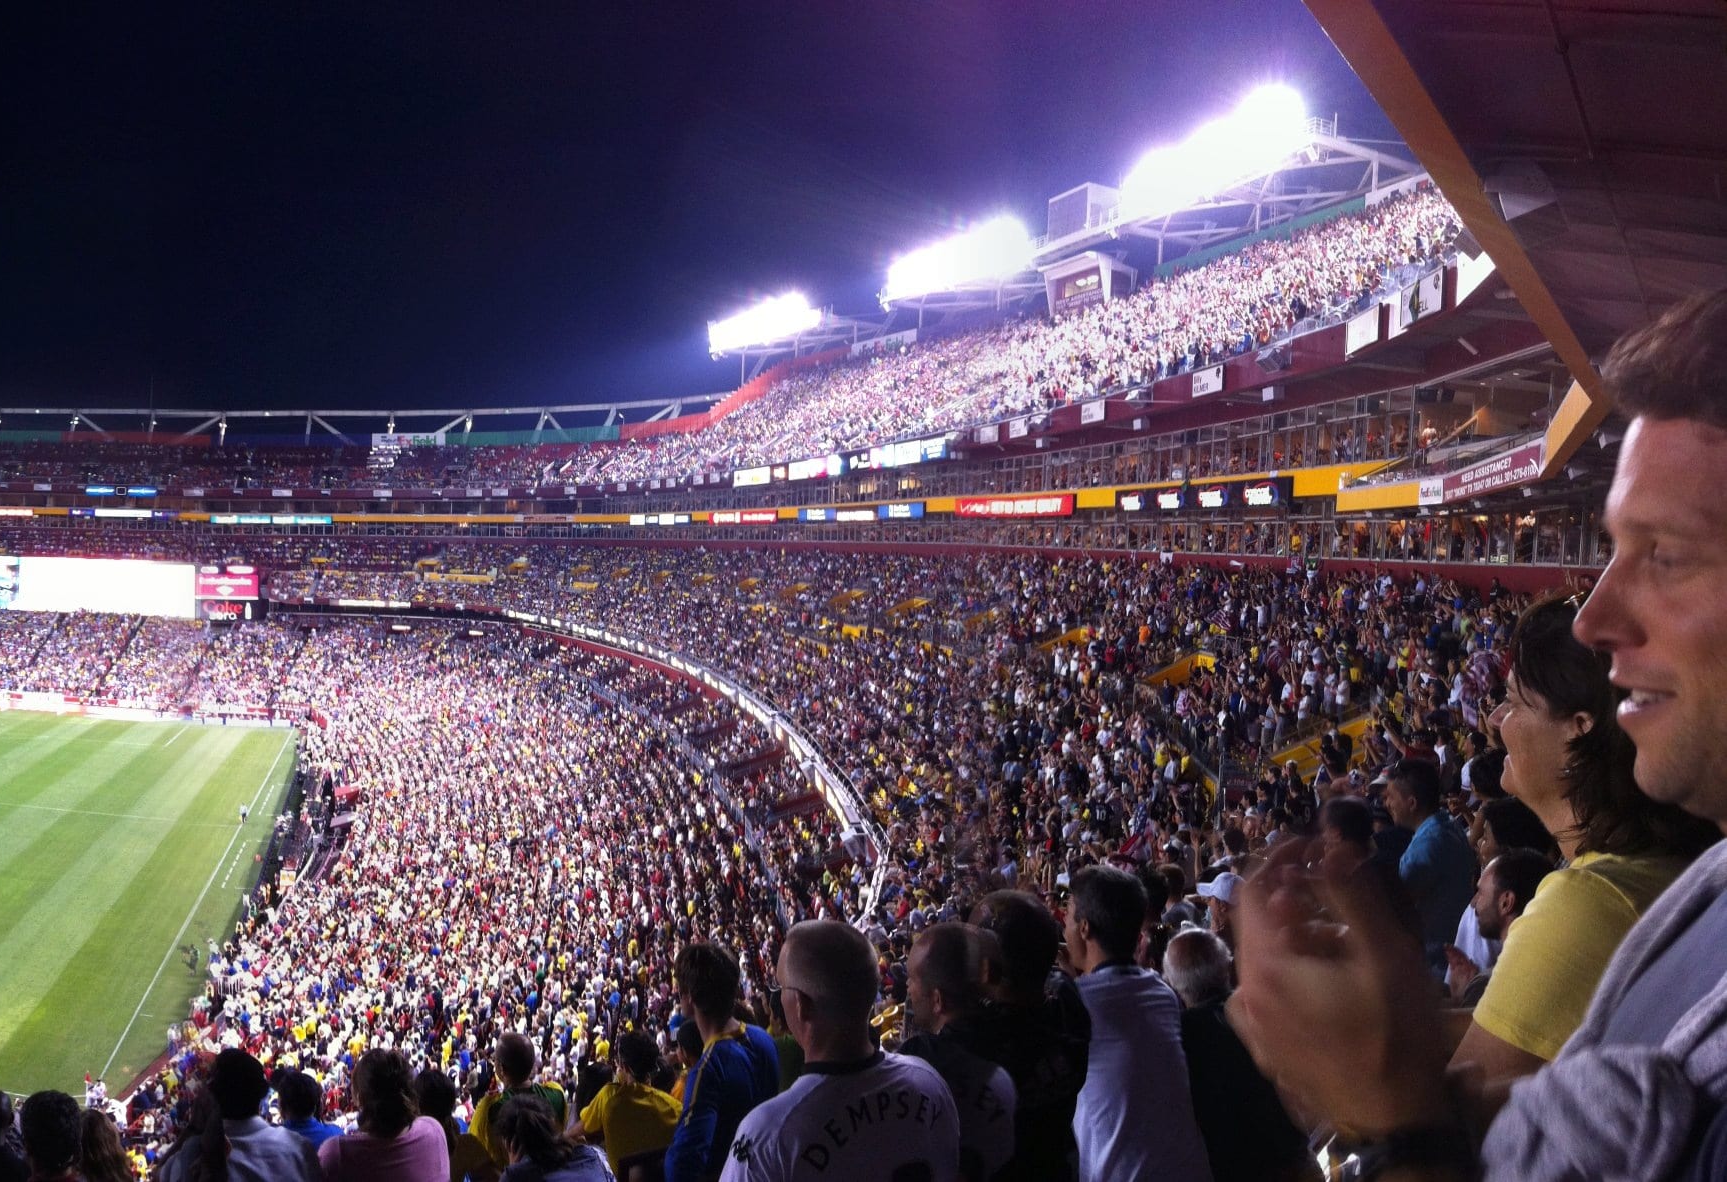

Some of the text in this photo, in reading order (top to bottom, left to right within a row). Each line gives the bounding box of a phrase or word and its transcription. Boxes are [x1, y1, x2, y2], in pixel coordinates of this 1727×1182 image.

[1461, 457, 1512, 483] NEED ASSISTANCE?
[1485, 479, 1491, 489] OR
[1491, 474, 1504, 487] CALL
[202, 600, 243, 614] Coke
[1095, 808, 1107, 822] 10
[1304, 805, 1311, 824] 9
[801, 1090, 943, 1173] DEMPSEY
